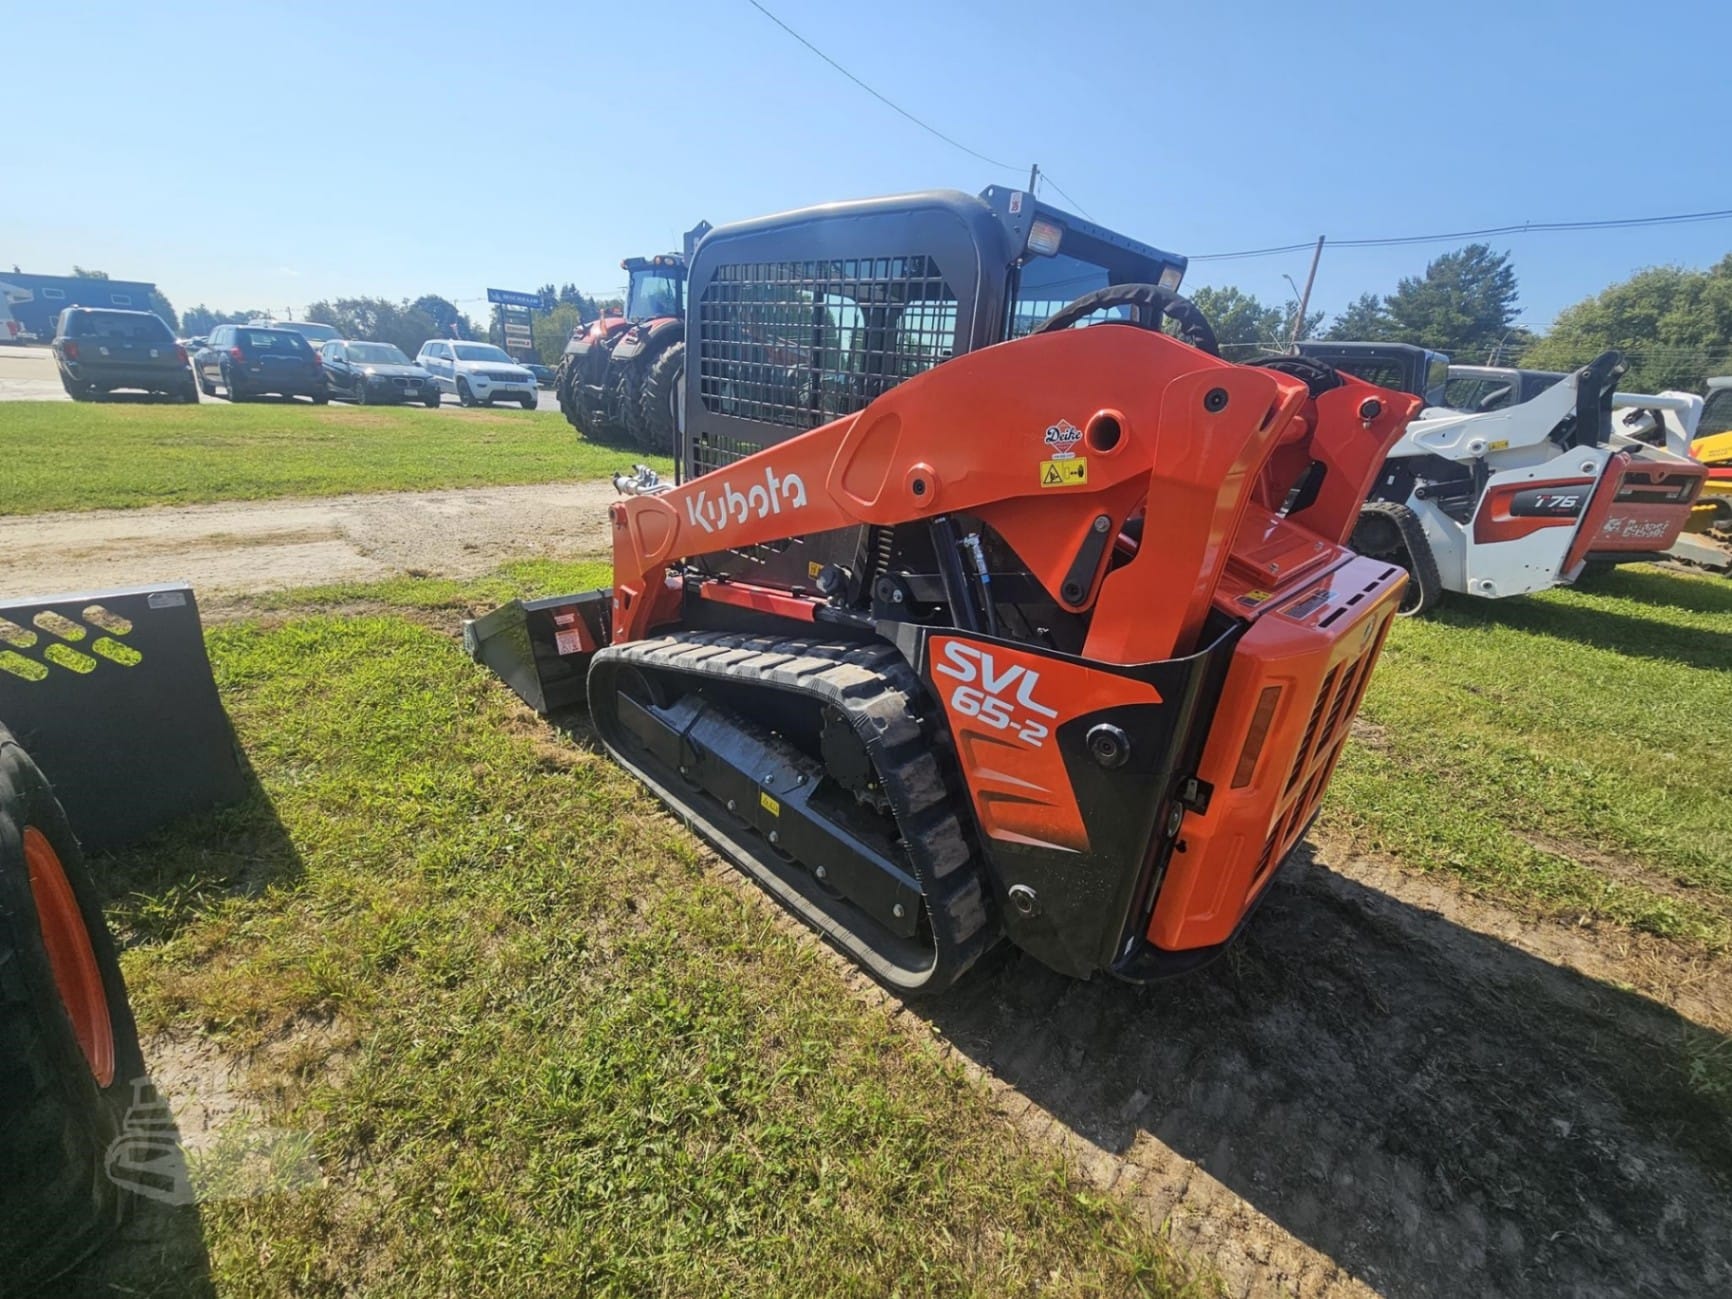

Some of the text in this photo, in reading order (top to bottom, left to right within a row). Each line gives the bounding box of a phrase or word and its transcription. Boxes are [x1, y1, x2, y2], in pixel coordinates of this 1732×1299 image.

[686, 466, 808, 534] Kubota
[936, 640, 1058, 719] SVL
[951, 685, 1049, 748] 65-2
